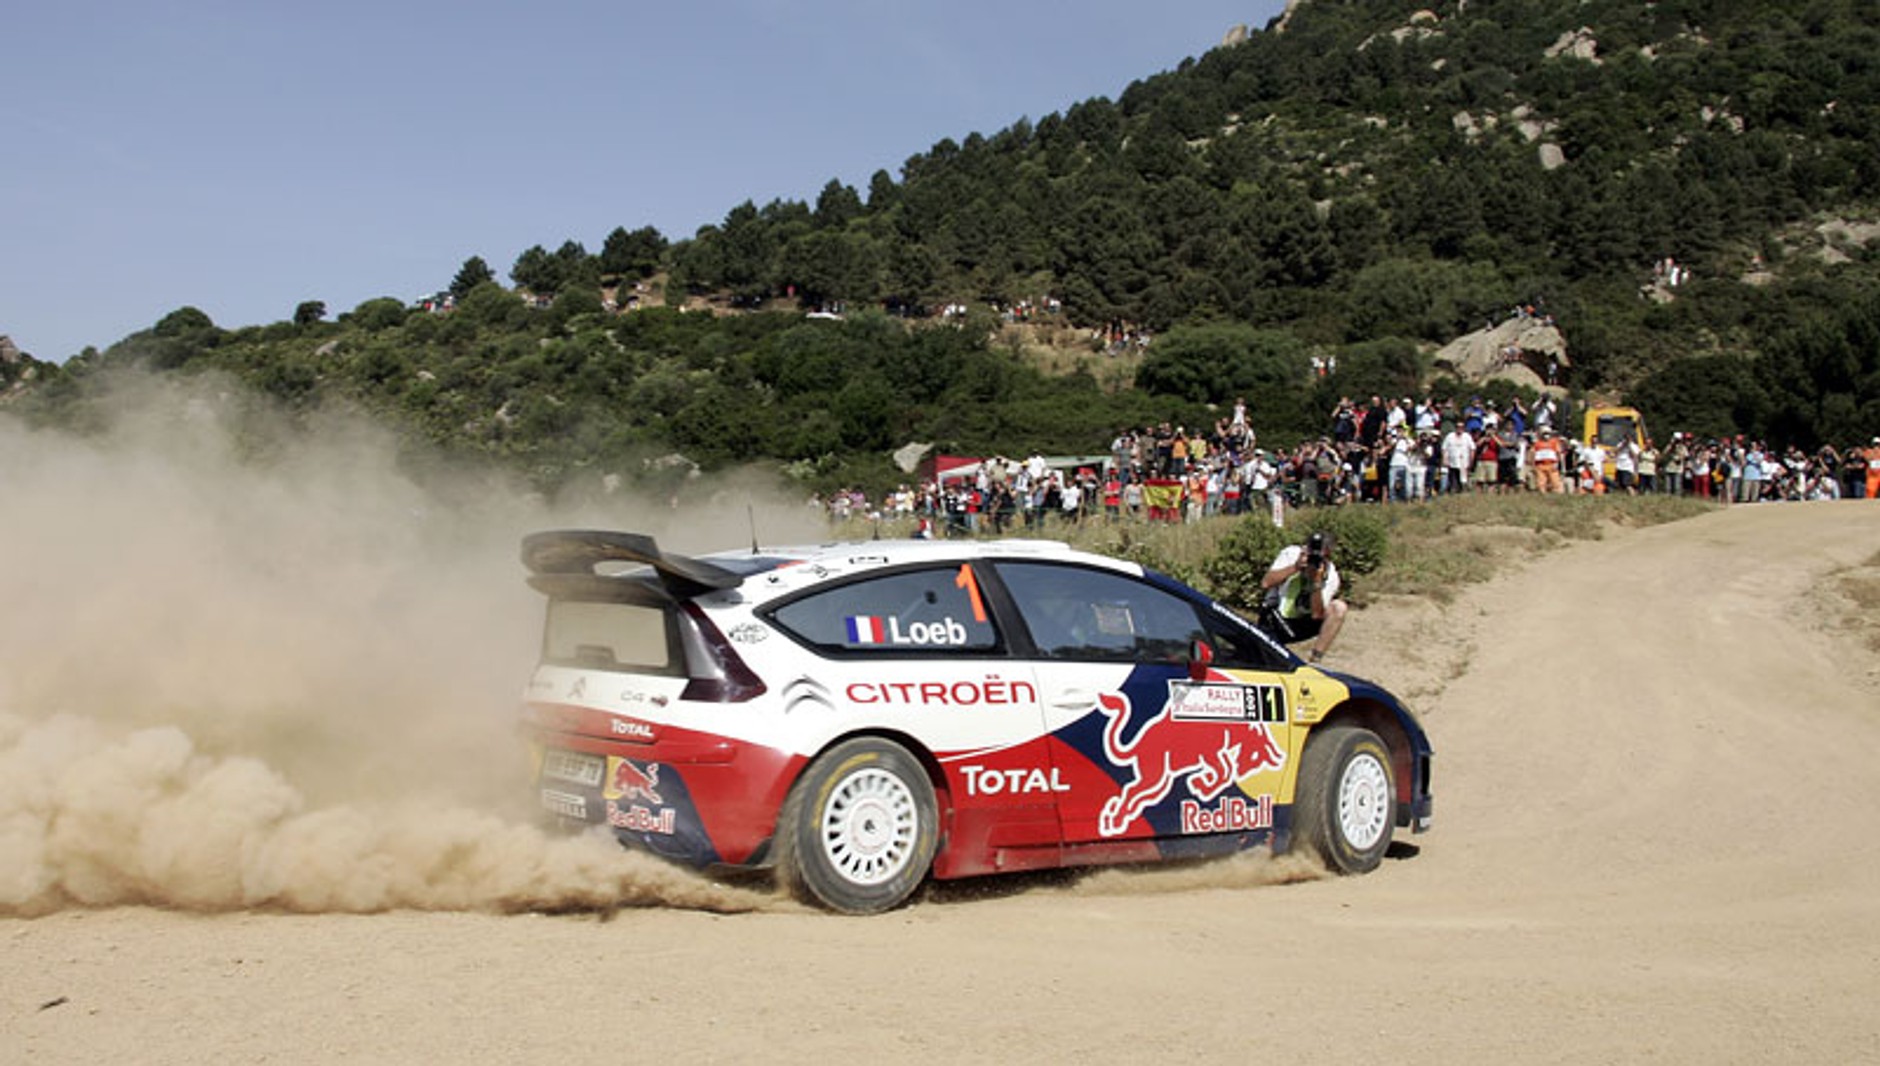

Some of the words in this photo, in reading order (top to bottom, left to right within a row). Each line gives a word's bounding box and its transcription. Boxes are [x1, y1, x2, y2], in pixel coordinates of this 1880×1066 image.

[955, 563, 987, 622] 1
[888, 616, 967, 644] Loeb
[1207, 687, 1242, 702] RALLY
[1266, 687, 1278, 721] 1
